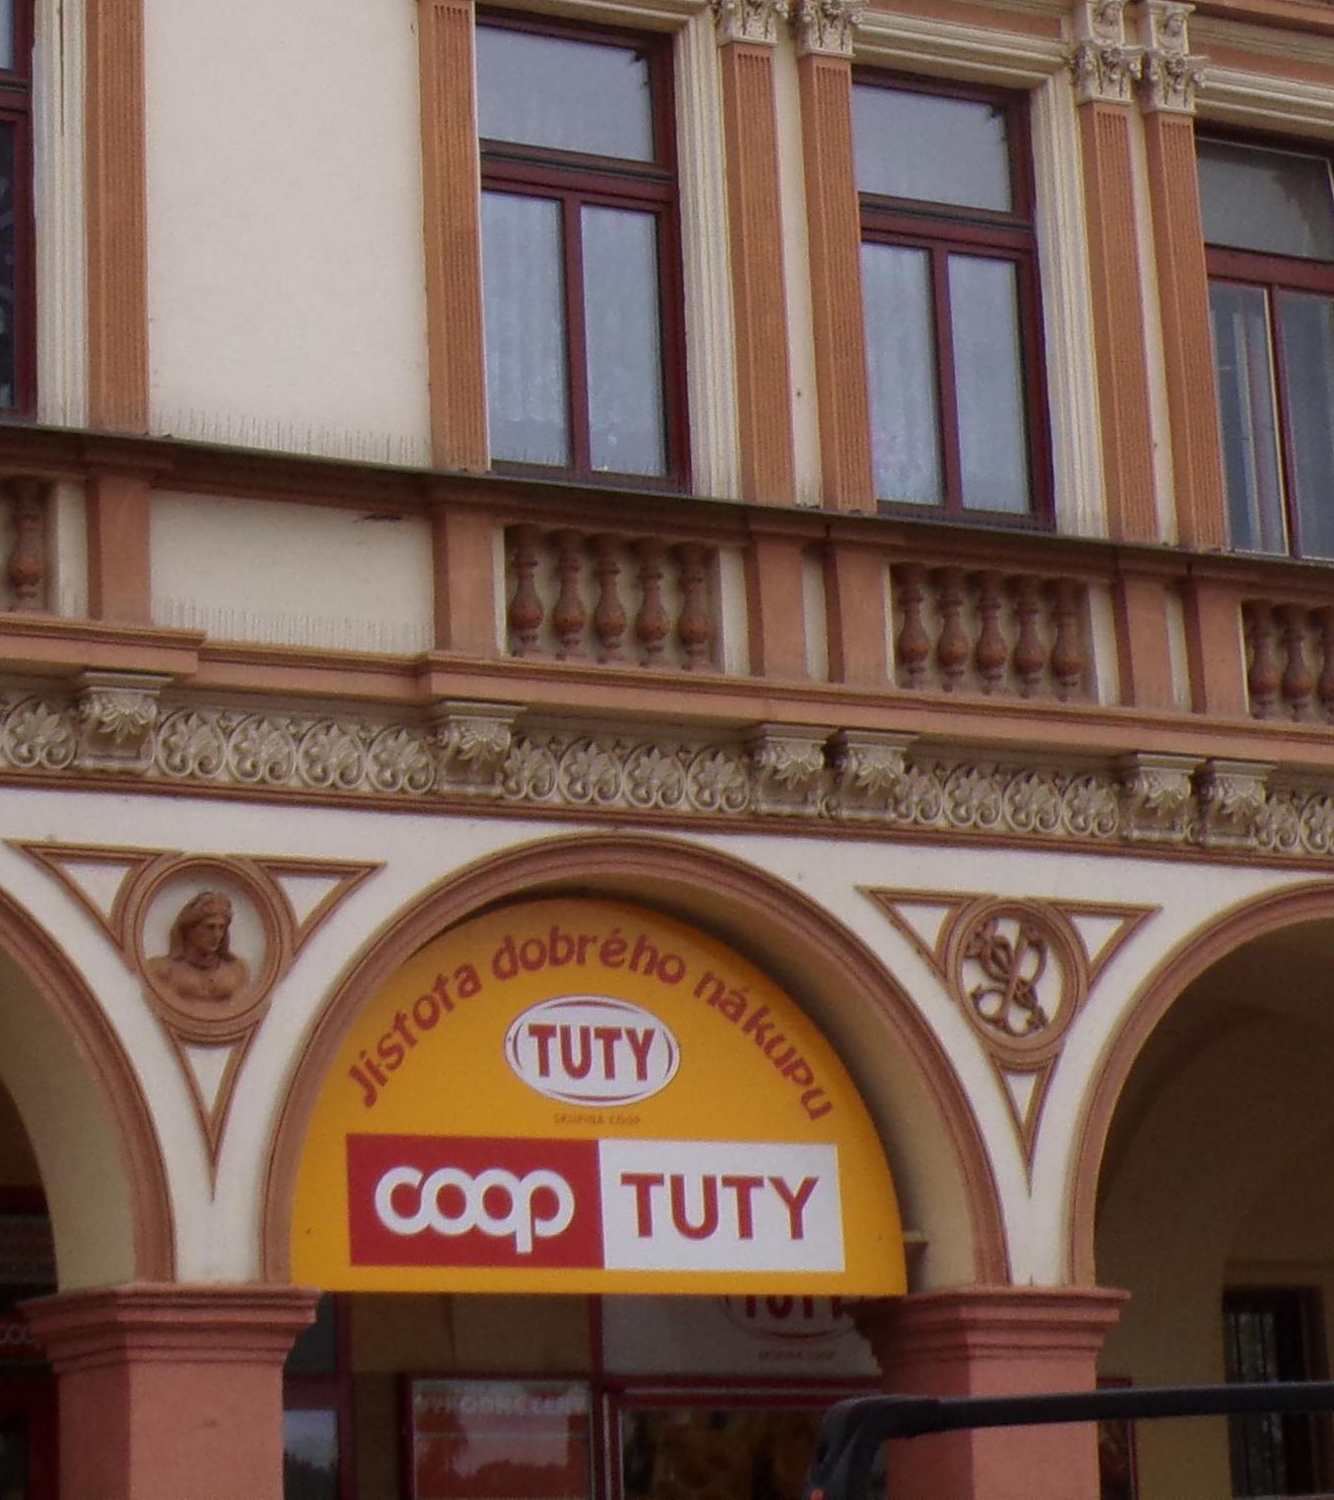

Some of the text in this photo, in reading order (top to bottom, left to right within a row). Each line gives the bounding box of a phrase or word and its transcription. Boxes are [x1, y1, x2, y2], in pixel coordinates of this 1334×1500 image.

[348, 925, 834, 1120] Jistota dobrého nákupu
[528, 1023, 656, 1081] TUTY
[375, 1166, 820, 1254] coop TUTY
